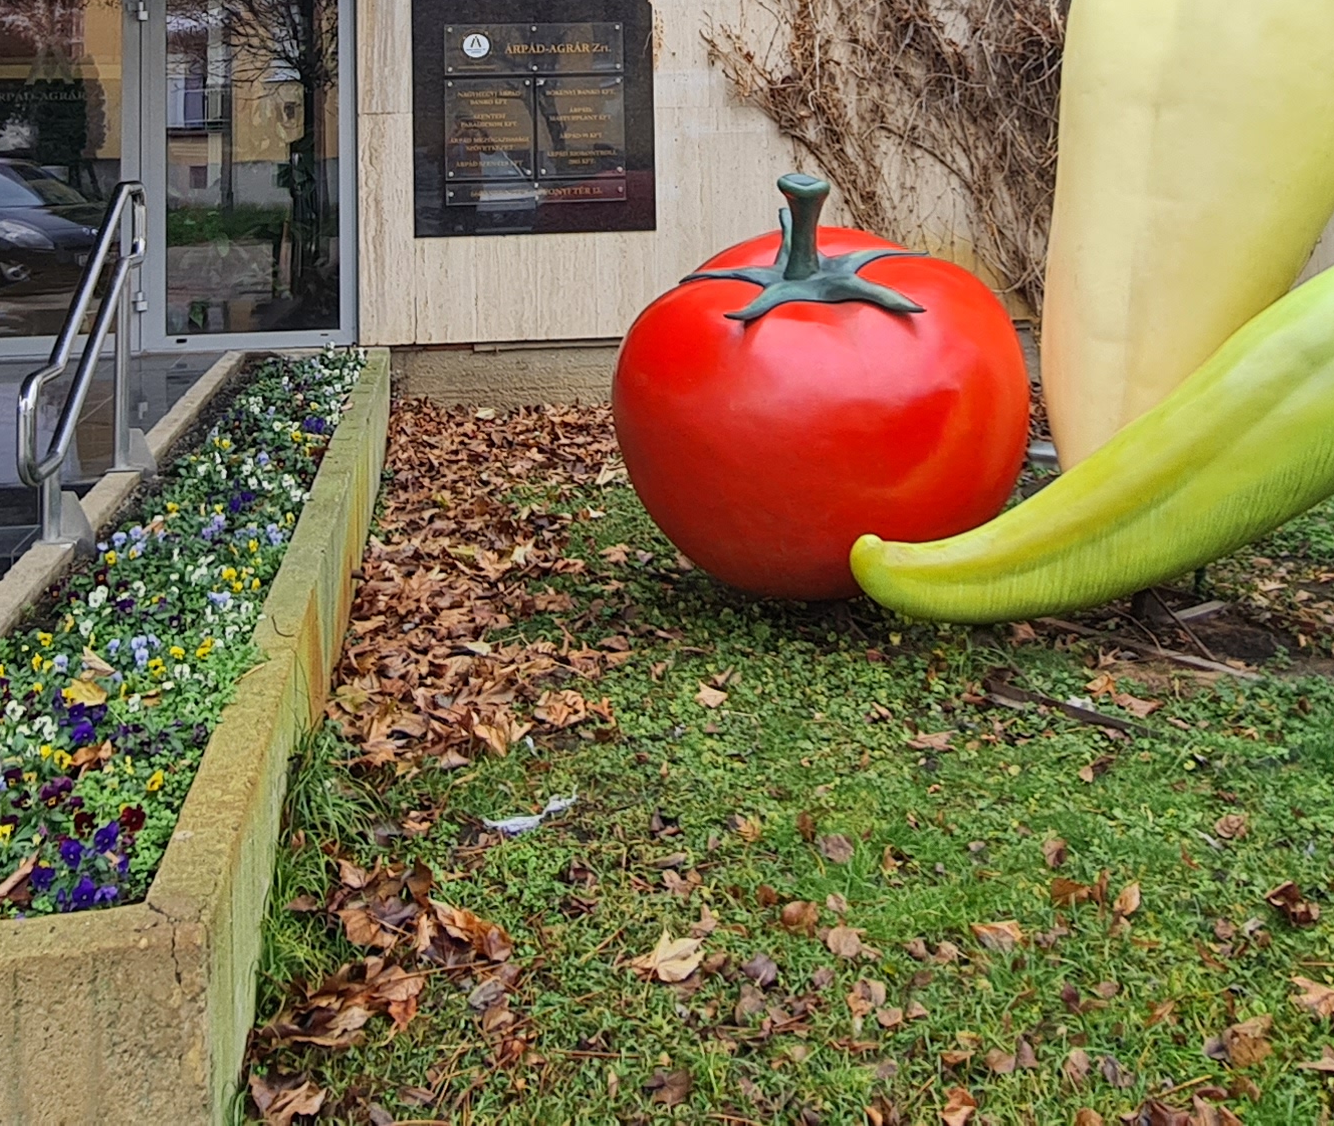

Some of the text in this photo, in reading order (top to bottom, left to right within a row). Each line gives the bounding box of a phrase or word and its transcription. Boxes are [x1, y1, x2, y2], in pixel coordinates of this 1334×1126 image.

[505, 42, 612, 55] ÁRPÁD-AGRÁR Zrt.
[573, 185, 591, 195] TÉR
